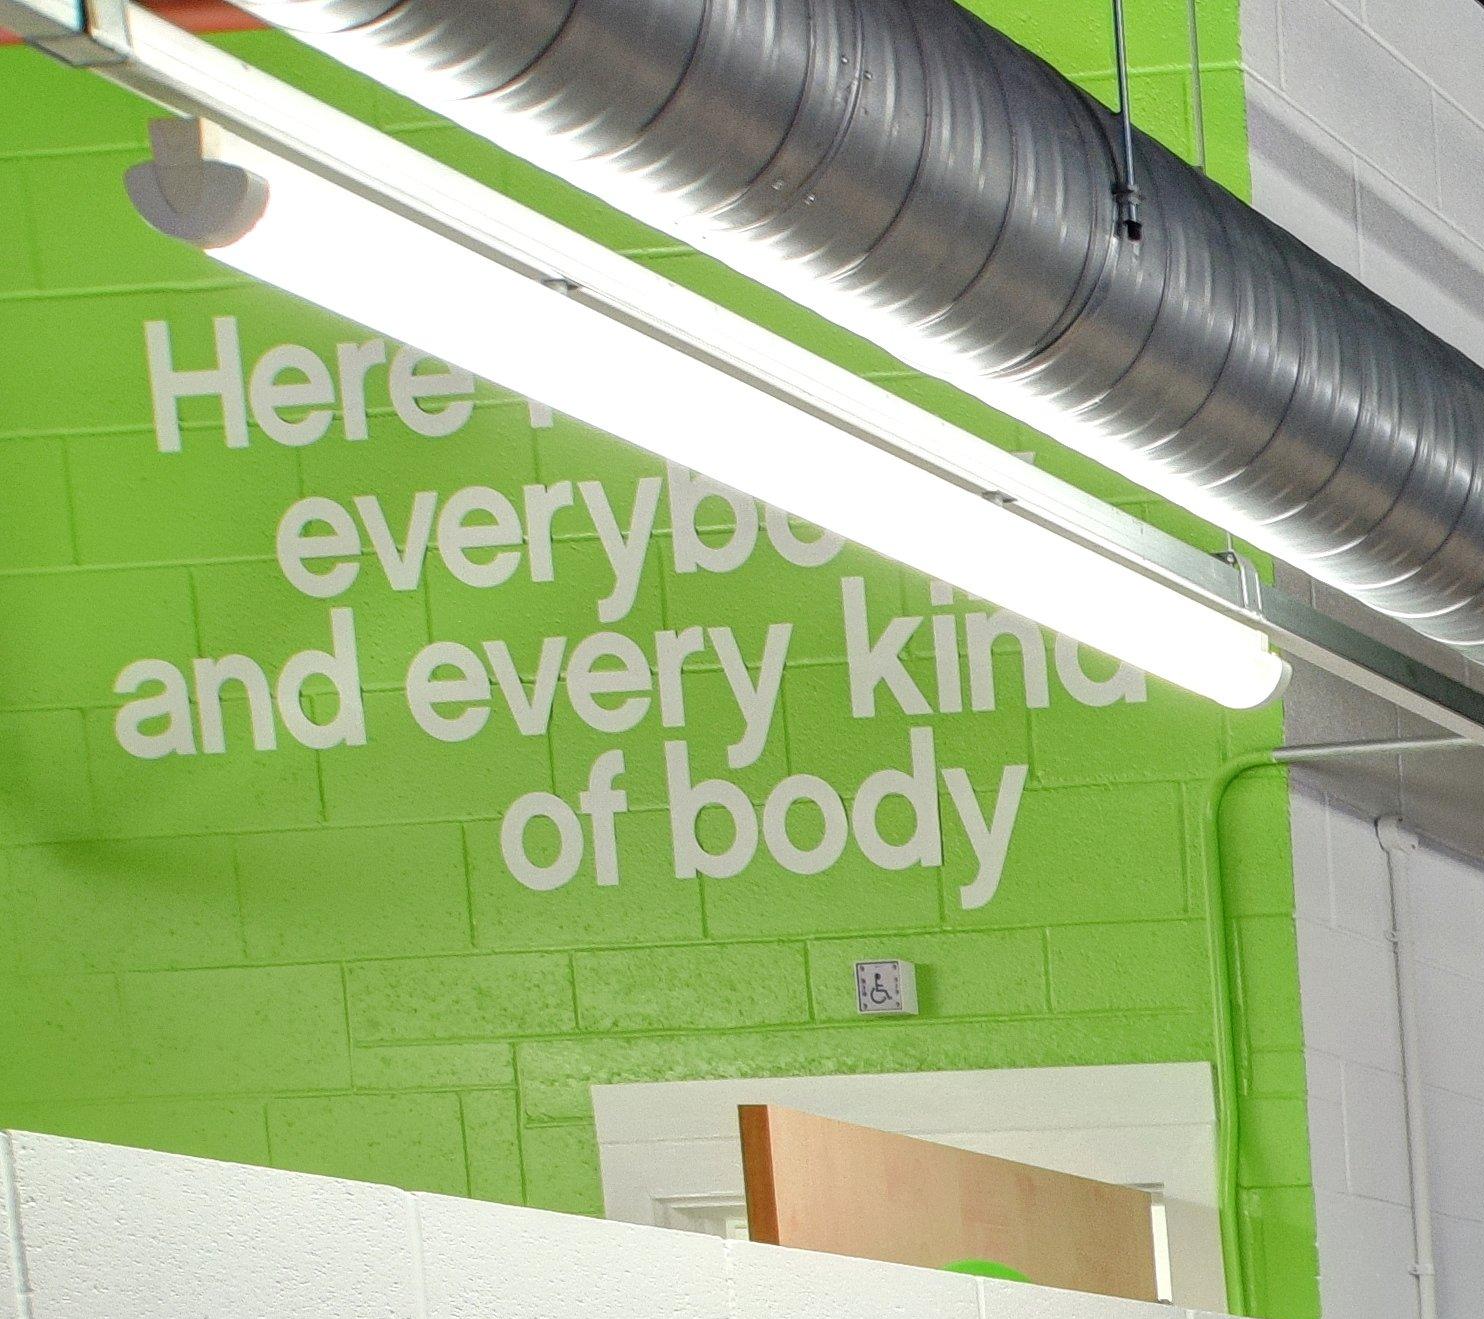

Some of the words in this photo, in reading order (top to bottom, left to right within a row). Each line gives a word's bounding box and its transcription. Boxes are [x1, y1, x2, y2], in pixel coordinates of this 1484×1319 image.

[144, 316, 475, 452] Here
[276, 460, 847, 624] everyb
[113, 606, 367, 759] and
[406, 624, 793, 769] every
[500, 749, 628, 891] of
[664, 726, 1029, 910] body
